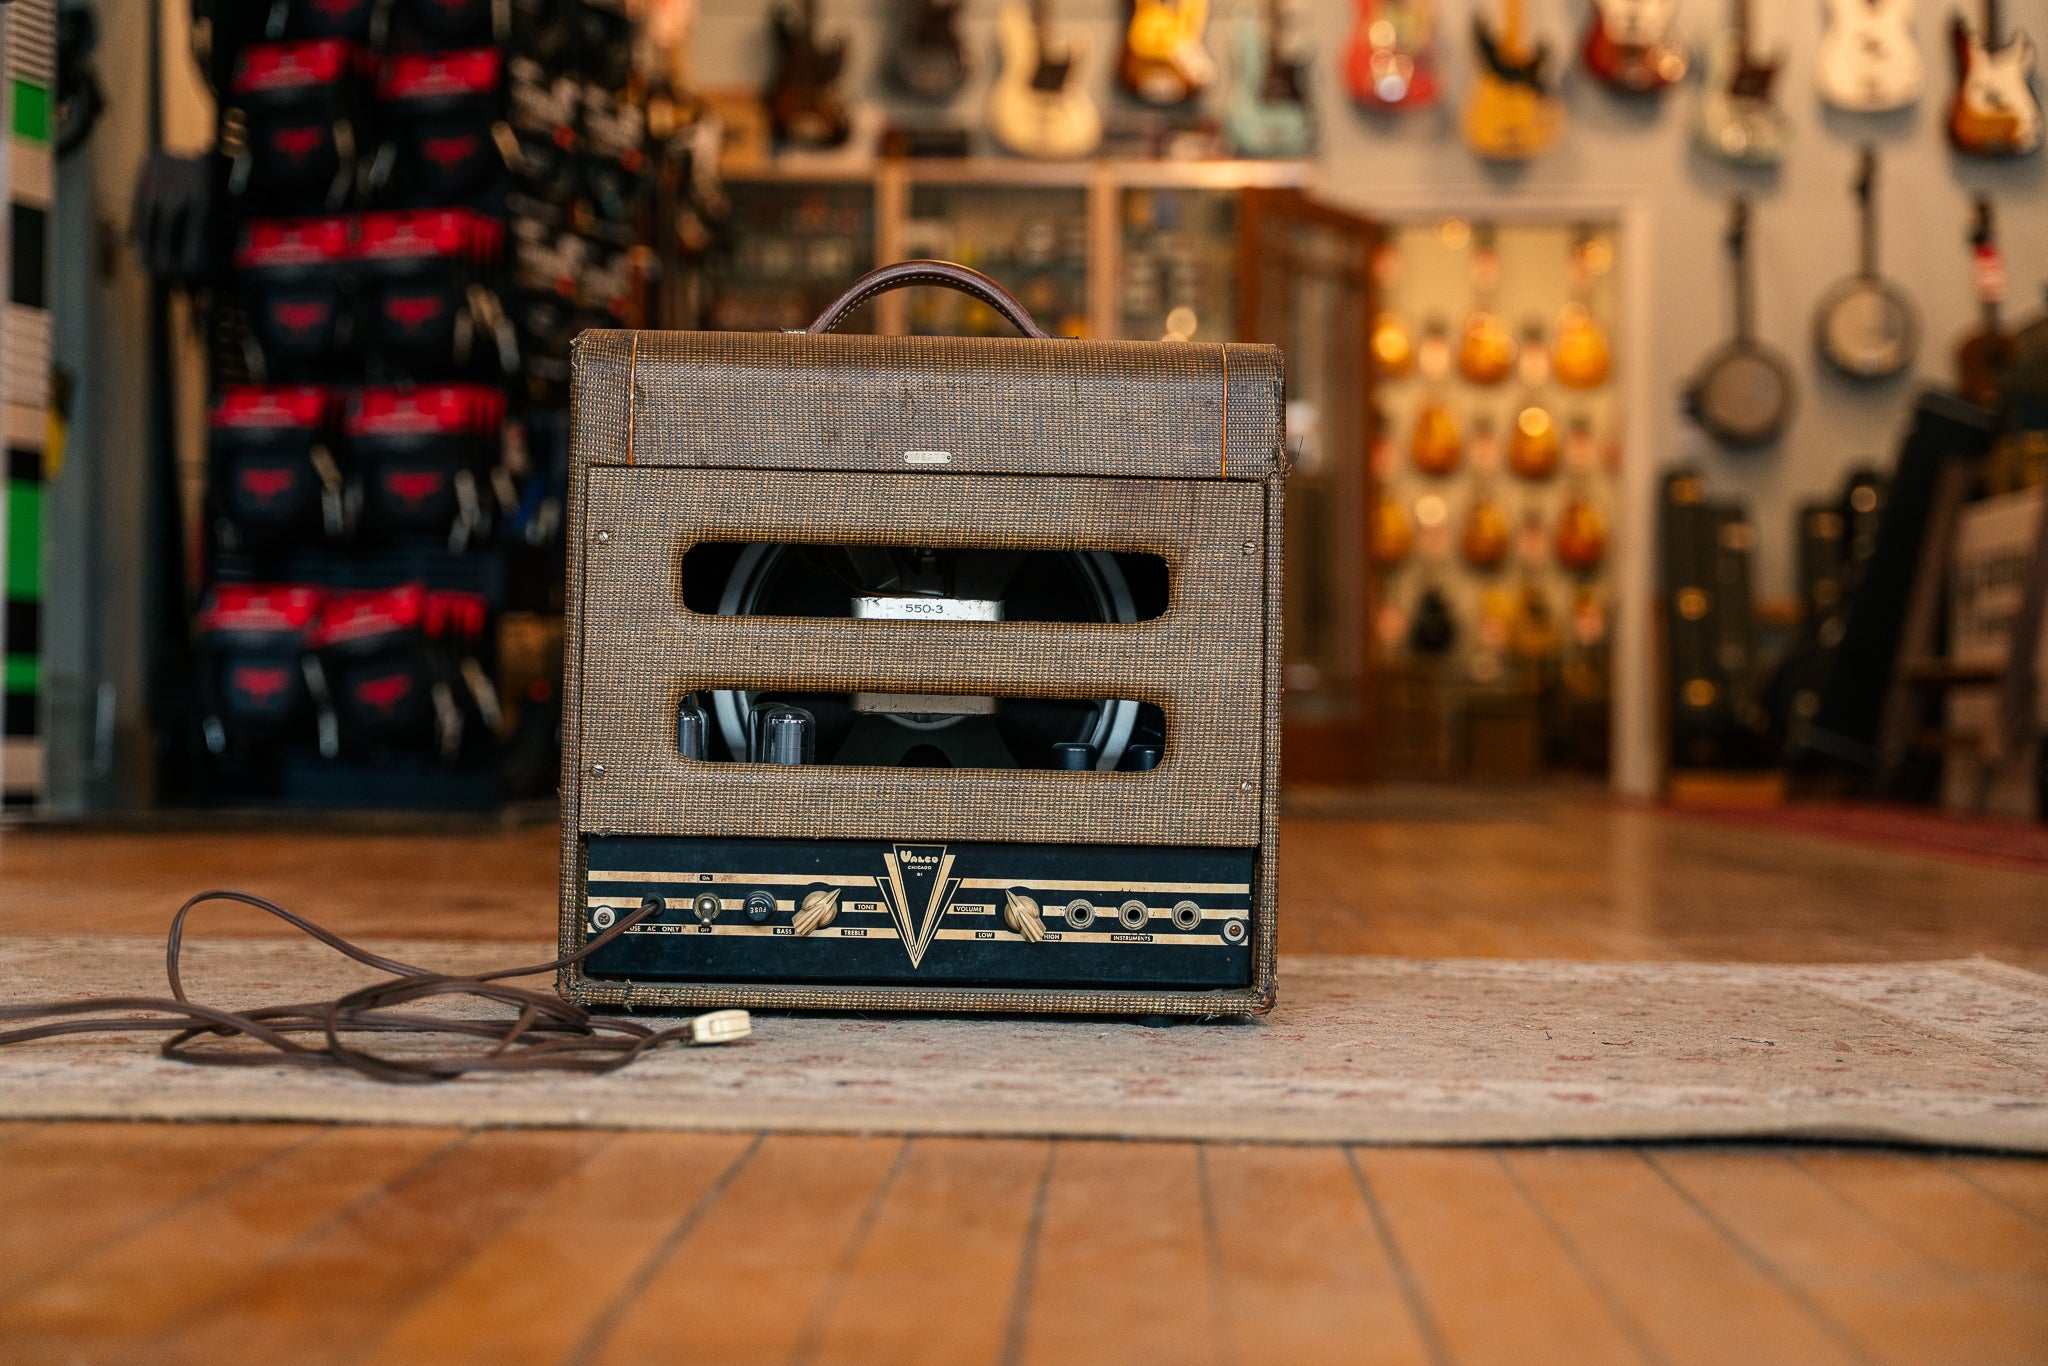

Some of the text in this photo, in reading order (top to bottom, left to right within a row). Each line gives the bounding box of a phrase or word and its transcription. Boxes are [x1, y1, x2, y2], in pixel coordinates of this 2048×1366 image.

[905, 604, 944, 614] 550-3
[900, 850, 939, 863] VALCO
[750, 906, 767, 914] FUSE
